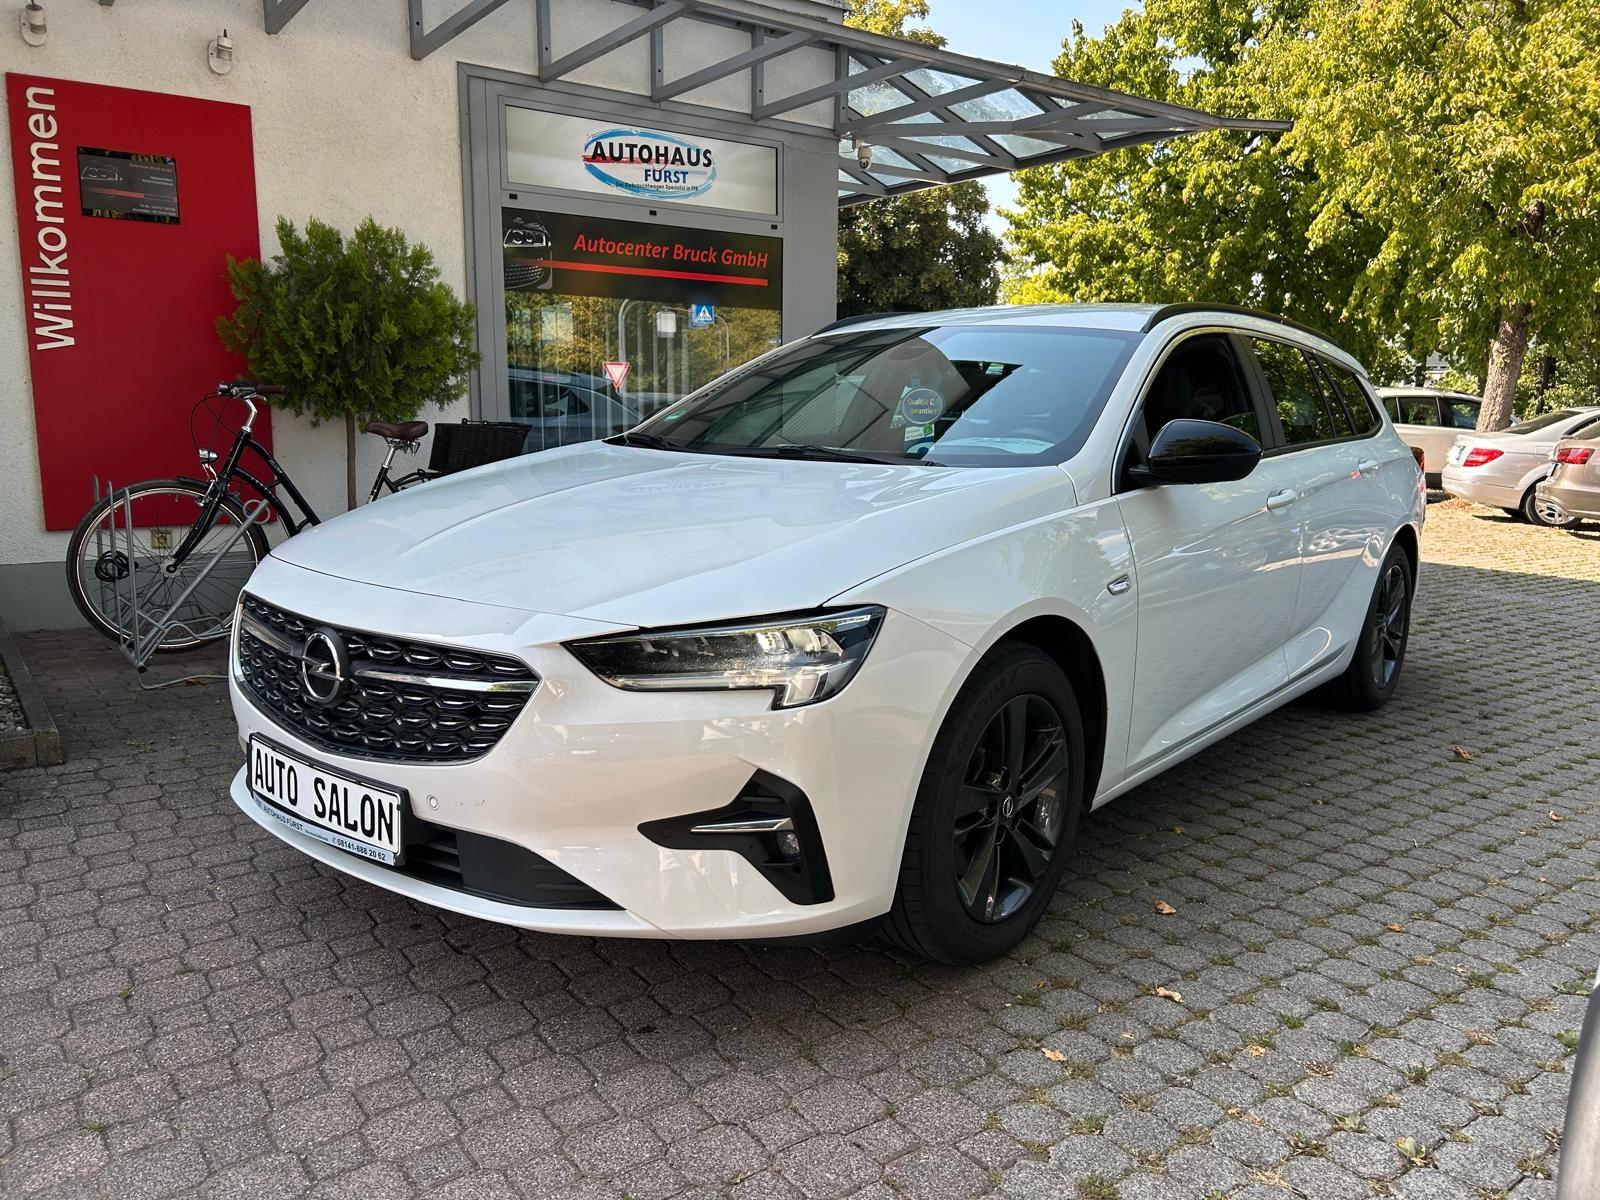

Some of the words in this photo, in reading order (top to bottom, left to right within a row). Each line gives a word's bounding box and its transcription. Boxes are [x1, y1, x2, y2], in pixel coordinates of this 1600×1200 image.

[591, 141, 712, 167] AUTOHAUS
[25, 86, 75, 350] Willkommen
[573, 234, 669, 259] Autocenter
[673, 244, 717, 264] Bruck
[721, 249, 769, 268] GmbH
[255, 748, 298, 807] AUTO
[313, 777, 394, 846] SALON
[263, 806, 287, 824] AUTOHAUS
[337, 838, 368, 855] 08141-888
[369, 849, 377, 858] 20
[377, 852, 387, 861] 62
